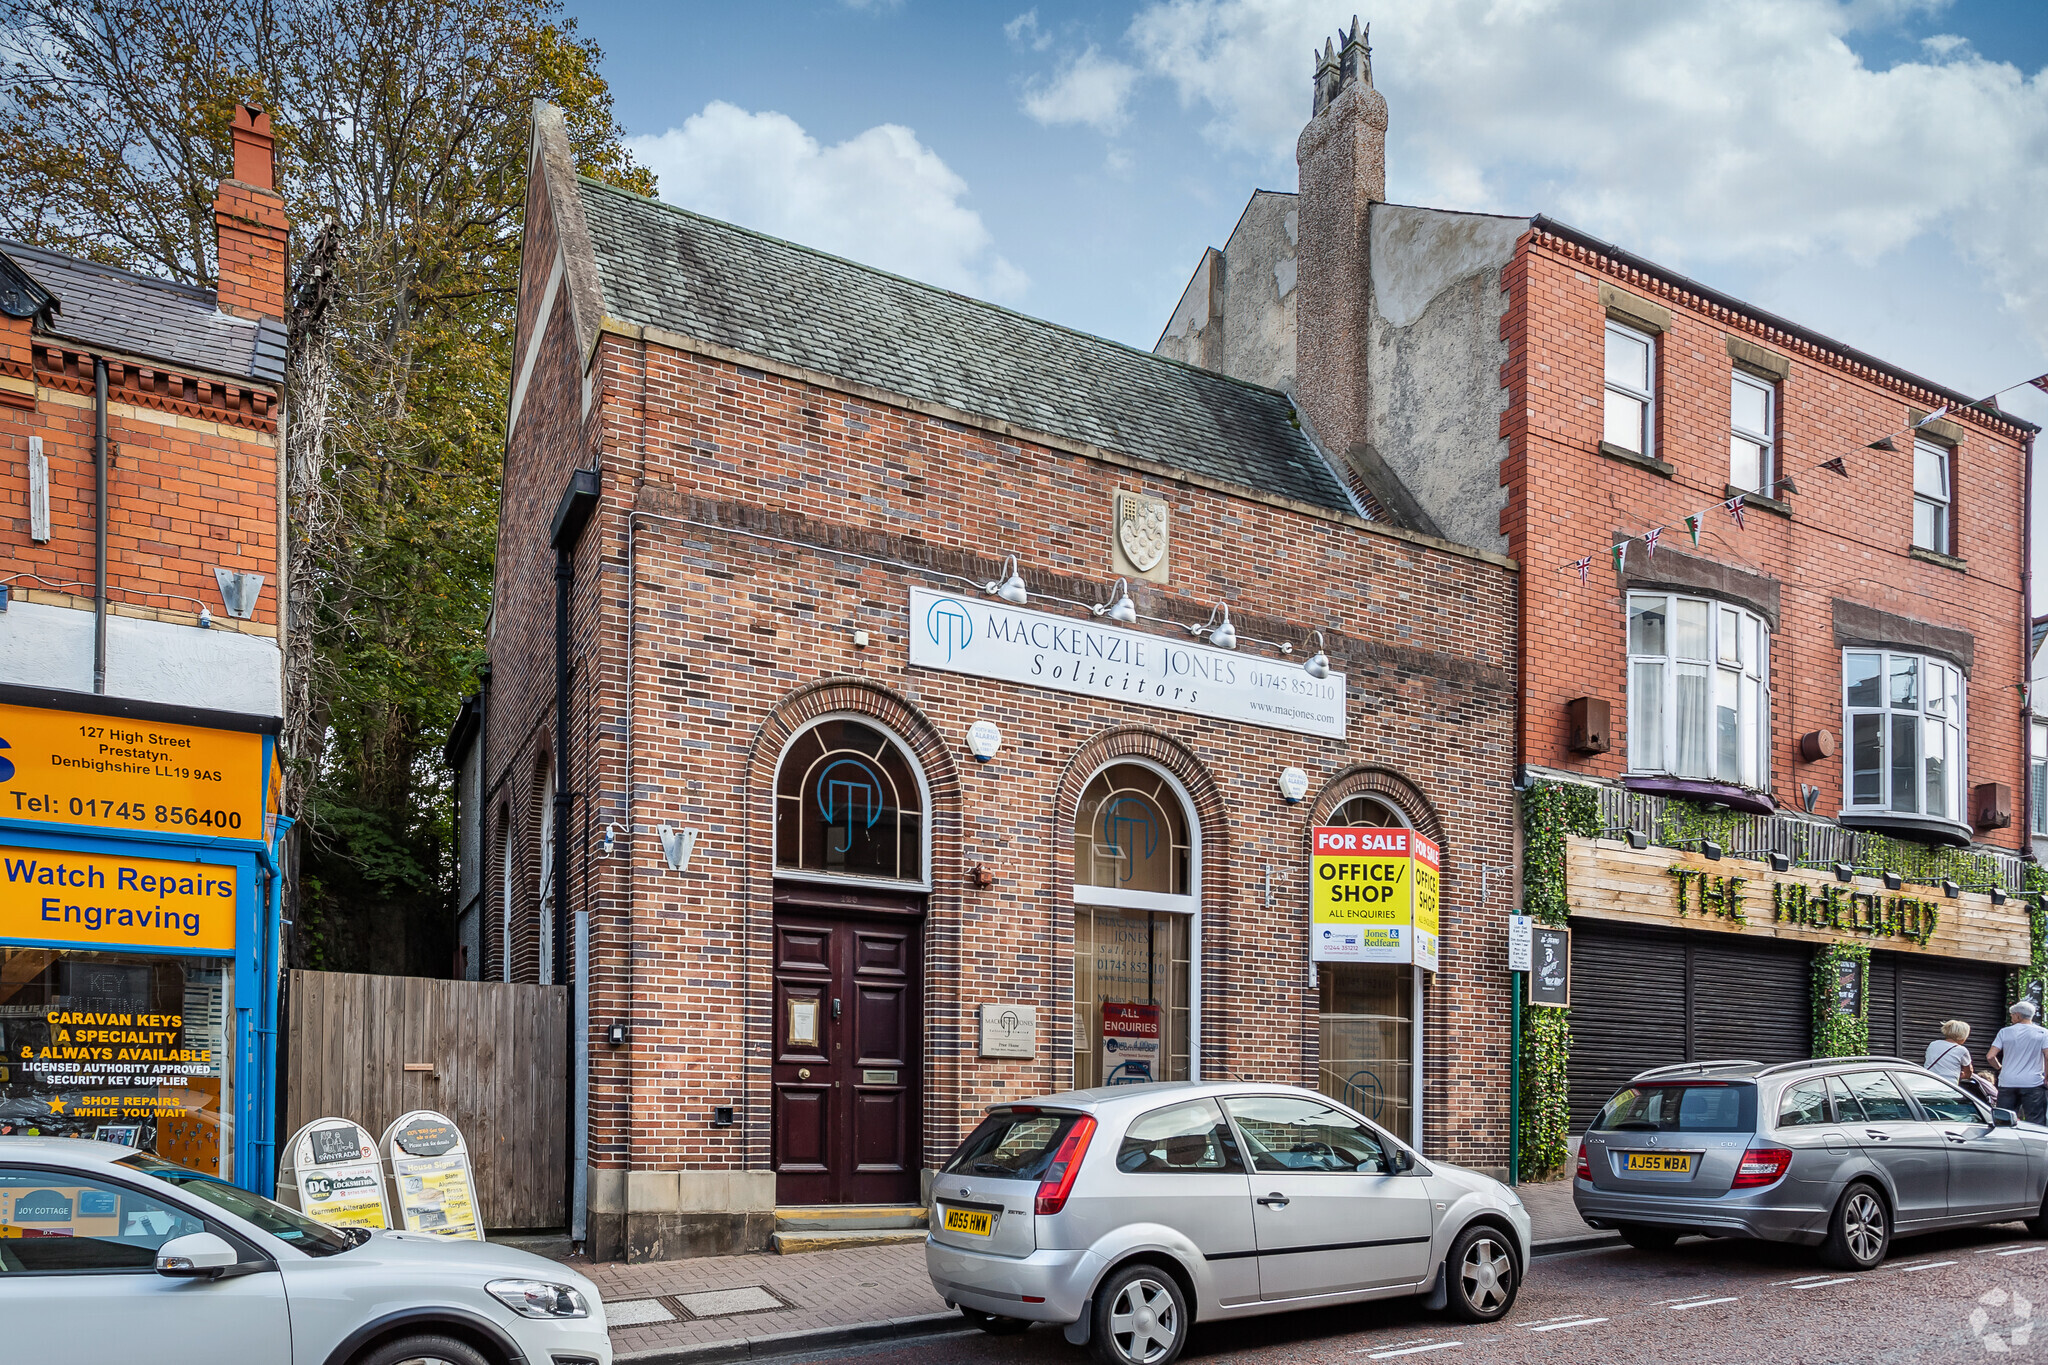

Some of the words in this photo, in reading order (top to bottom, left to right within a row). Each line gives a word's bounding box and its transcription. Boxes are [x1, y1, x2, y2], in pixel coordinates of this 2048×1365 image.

[986, 613, 1146, 668] MACKENZIE
[1163, 647, 1236, 685] JONES
[1031, 653, 1198, 704] Solicitors
[1250, 671, 1288, 691] 01745
[1291, 679, 1335, 700] 852110
[1249, 701, 1335, 724] www.macjones.com
[79, 726, 104, 739] 127
[110, 728, 143, 744] High
[148, 733, 191, 748] Street
[99, 744, 173, 762] Prestatyn.
[51, 754, 151, 775] Denbighshire
[155, 765, 189, 779] LL19
[193, 769, 222, 782] 9AS
[10, 791, 59, 813] Tel:
[69, 797, 146, 821] 01745
[154, 805, 242, 829] 856400
[1319, 834, 1356, 850] FOR
[1362, 834, 1406, 851] SALE
[1415, 839, 1427, 858] FOR
[1427, 844, 1439, 866] SALE
[4, 858, 105, 889] Watch
[117, 867, 233, 898] Repairs
[1319, 863, 1405, 884] OFFICE/
[1331, 885, 1394, 903] SHOP
[1667, 868, 1749, 919] THE
[1419, 891, 1435, 913] SHOP
[41, 897, 200, 936] Engraving
[1329, 910, 1344, 918] ALL
[1347, 910, 1396, 919] ENQUIRIES
[1115, 930, 1150, 944] JONES
[1366, 929, 1387, 938] Jones
[1390, 929, 1399, 938] &
[1364, 938, 1400, 947] Redfearn
[1097, 959, 1127, 972] 01745
[91, 974, 125, 992] KEY
[47, 1012, 132, 1026] CARAVAN
[137, 1014, 182, 1027] KEYS
[1121, 1008, 1139, 1018] ALL
[1104, 1021, 1157, 1033] ENQUIRIES
[57, 1029, 71, 1042] A
[75, 1030, 177, 1044] SPECIALITY
[21, 1046, 34, 1058] &
[39, 1047, 113, 1060] ALWAYS
[117, 1048, 211, 1062] AVAILABLE
[22, 1062, 81, 1073] LICENSED
[83, 1063, 150, 1074] AUTHORITY
[152, 1064, 210, 1075] APPROVED
[47, 1075, 104, 1086] SECURITY
[107, 1075, 132, 1086] KEY
[134, 1076, 188, 1086] SUPPLIER
[82, 1096, 120, 1106] SHOE
[123, 1096, 180, 1107] REPAIRS
[74, 1108, 118, 1118] WHILE
[122, 1108, 150, 1118] YOU
[154, 1108, 187, 1118] WAIT
[407, 1163, 432, 1172] House
[434, 1161, 456, 1170] Signs
[1631, 1156, 1661, 1170] AJ55
[1663, 1157, 1687, 1170] WBA
[308, 1179, 330, 1194] DC
[333, 1179, 374, 1189] LOCKSMITHS
[18, 1207, 33, 1215] JOY
[35, 1207, 69, 1215] COTTAGE
[311, 1206, 341, 1216] Garment
[342, 1202, 380, 1212] Alterations
[340, 1219, 346, 1227] in
[349, 1218, 371, 1226] Jeans,
